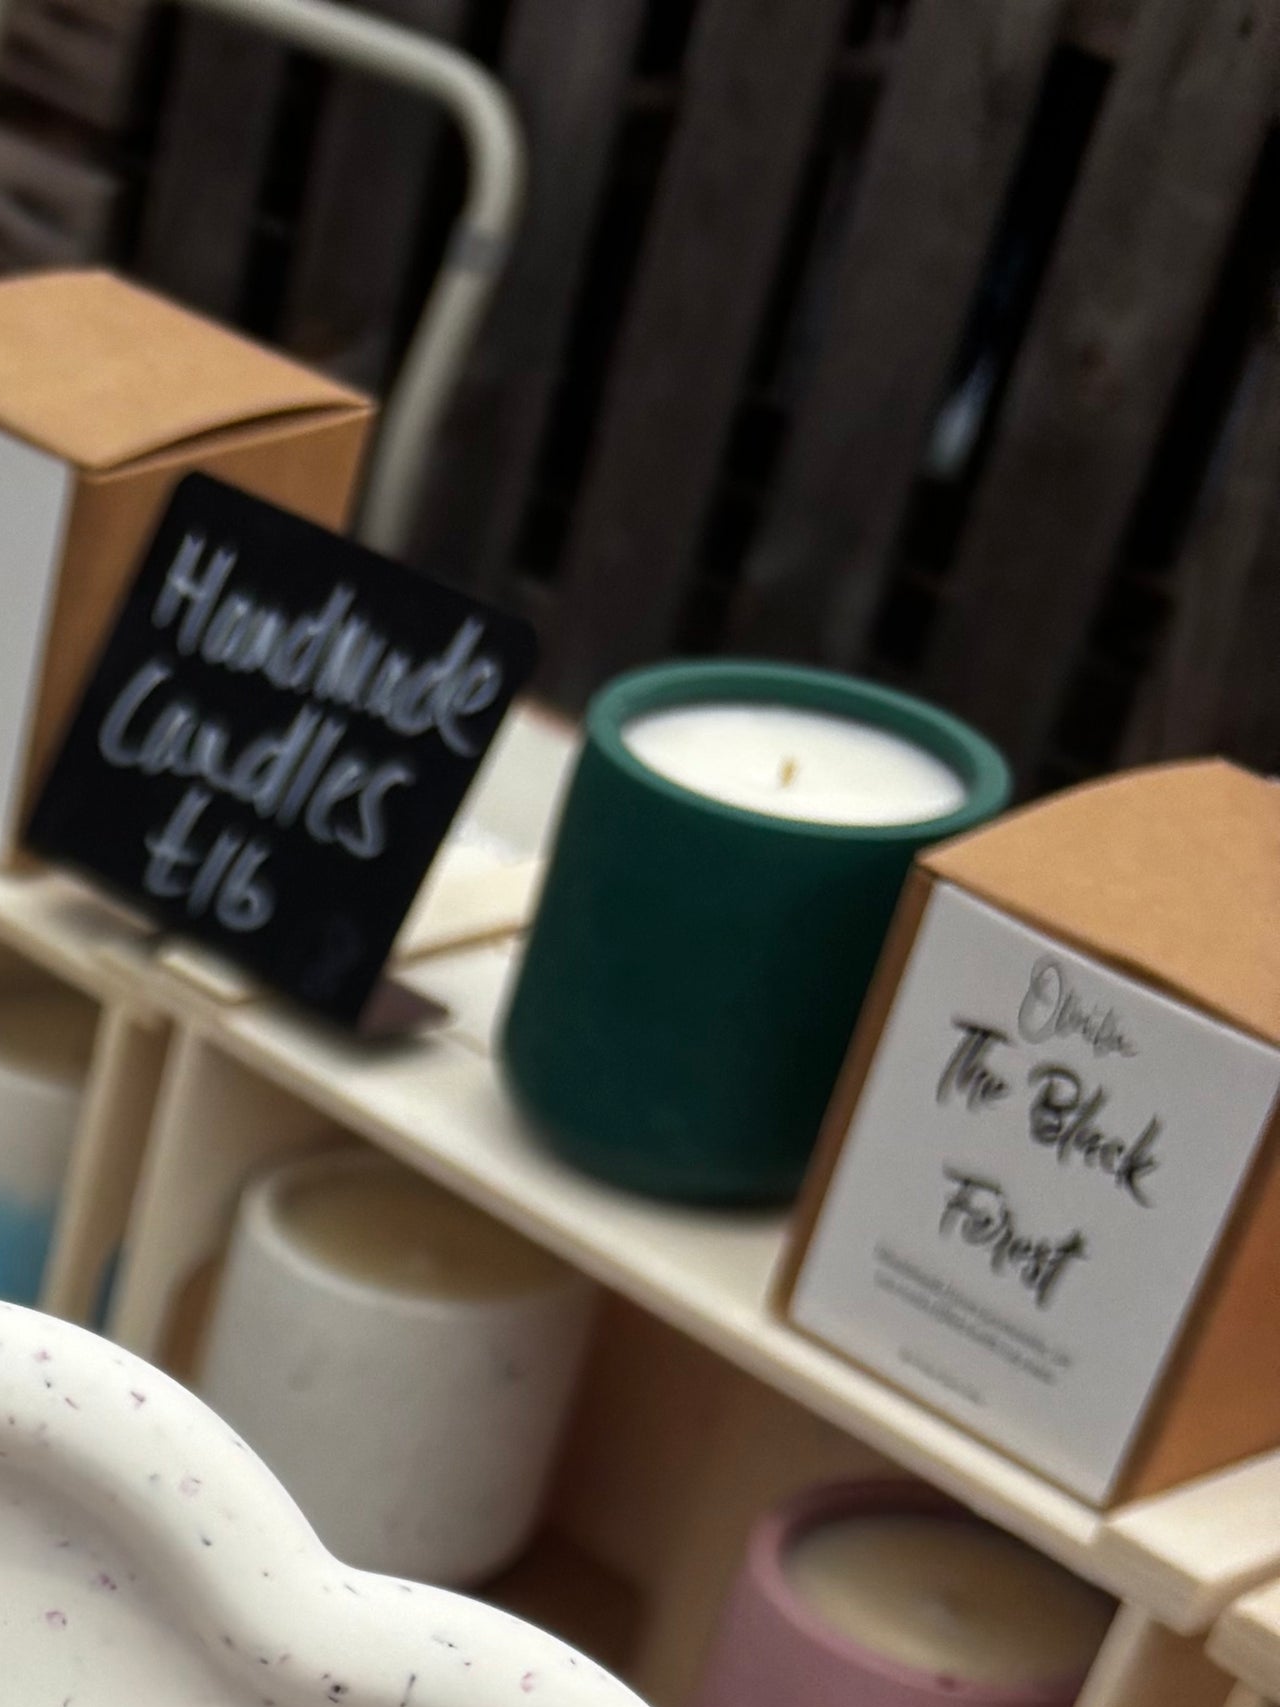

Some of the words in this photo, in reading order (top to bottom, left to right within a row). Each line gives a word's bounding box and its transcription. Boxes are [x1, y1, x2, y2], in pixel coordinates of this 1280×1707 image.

[153, 531, 502, 758] Handmade
[99, 655, 414, 860] Candles
[143, 787, 275, 932] £16
[934, 1017, 1011, 1109] The
[1028, 1063, 1160, 1209] Black
[937, 1167, 1089, 1308] Forest
